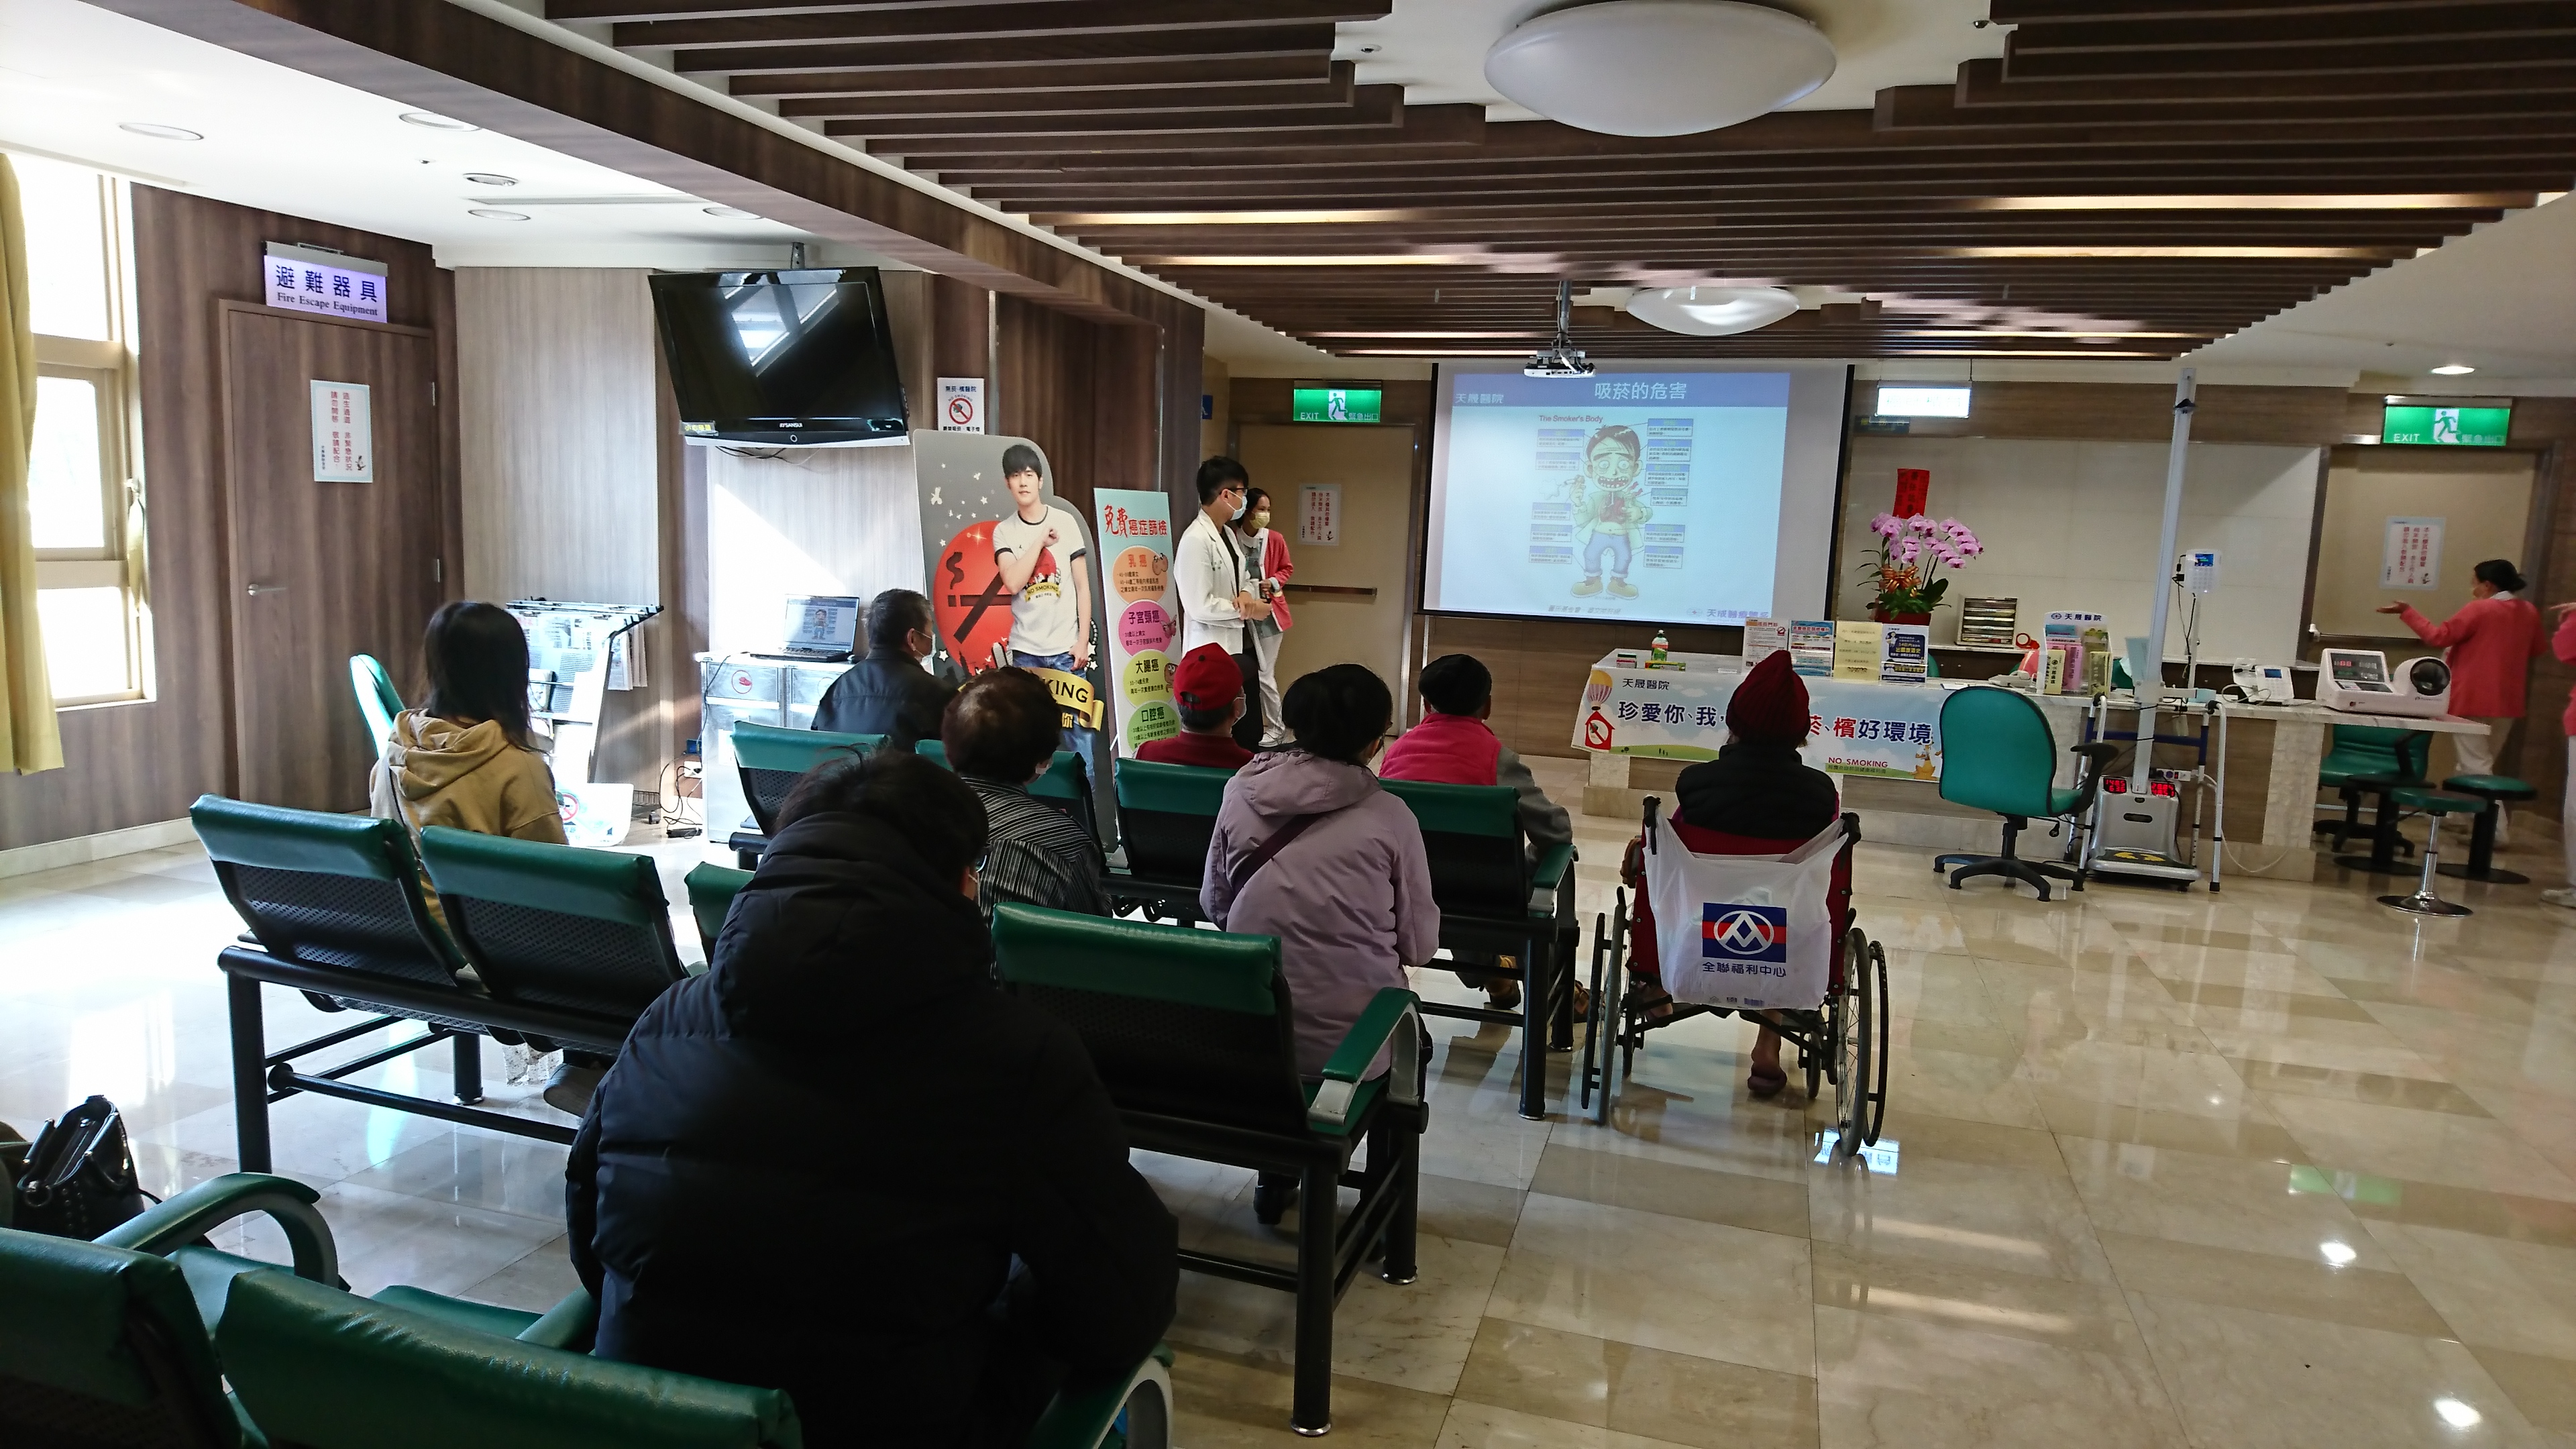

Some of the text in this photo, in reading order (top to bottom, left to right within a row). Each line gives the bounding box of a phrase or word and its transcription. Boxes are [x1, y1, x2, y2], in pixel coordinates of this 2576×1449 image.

[276, 264, 377, 303] 避難器具
[277, 292, 378, 316] Fire Escape Equipment
[1594, 382, 1688, 400] 吸菸的危害
[1300, 412, 1320, 420] EXIT
[1348, 412, 1379, 421] 緊急出口
[1585, 415, 1603, 423] Body
[2394, 433, 2420, 442] EXIT
[1128, 610, 1160, 625] 子宮頸癌
[1135, 659, 1159, 674] 大腸癌
[1623, 678, 1670, 690] 天晟醫院
[1141, 706, 1165, 722] 口腔癌
[1846, 759, 1888, 768] SMOKING
[1702, 961, 1786, 977] 全聯福利中心
